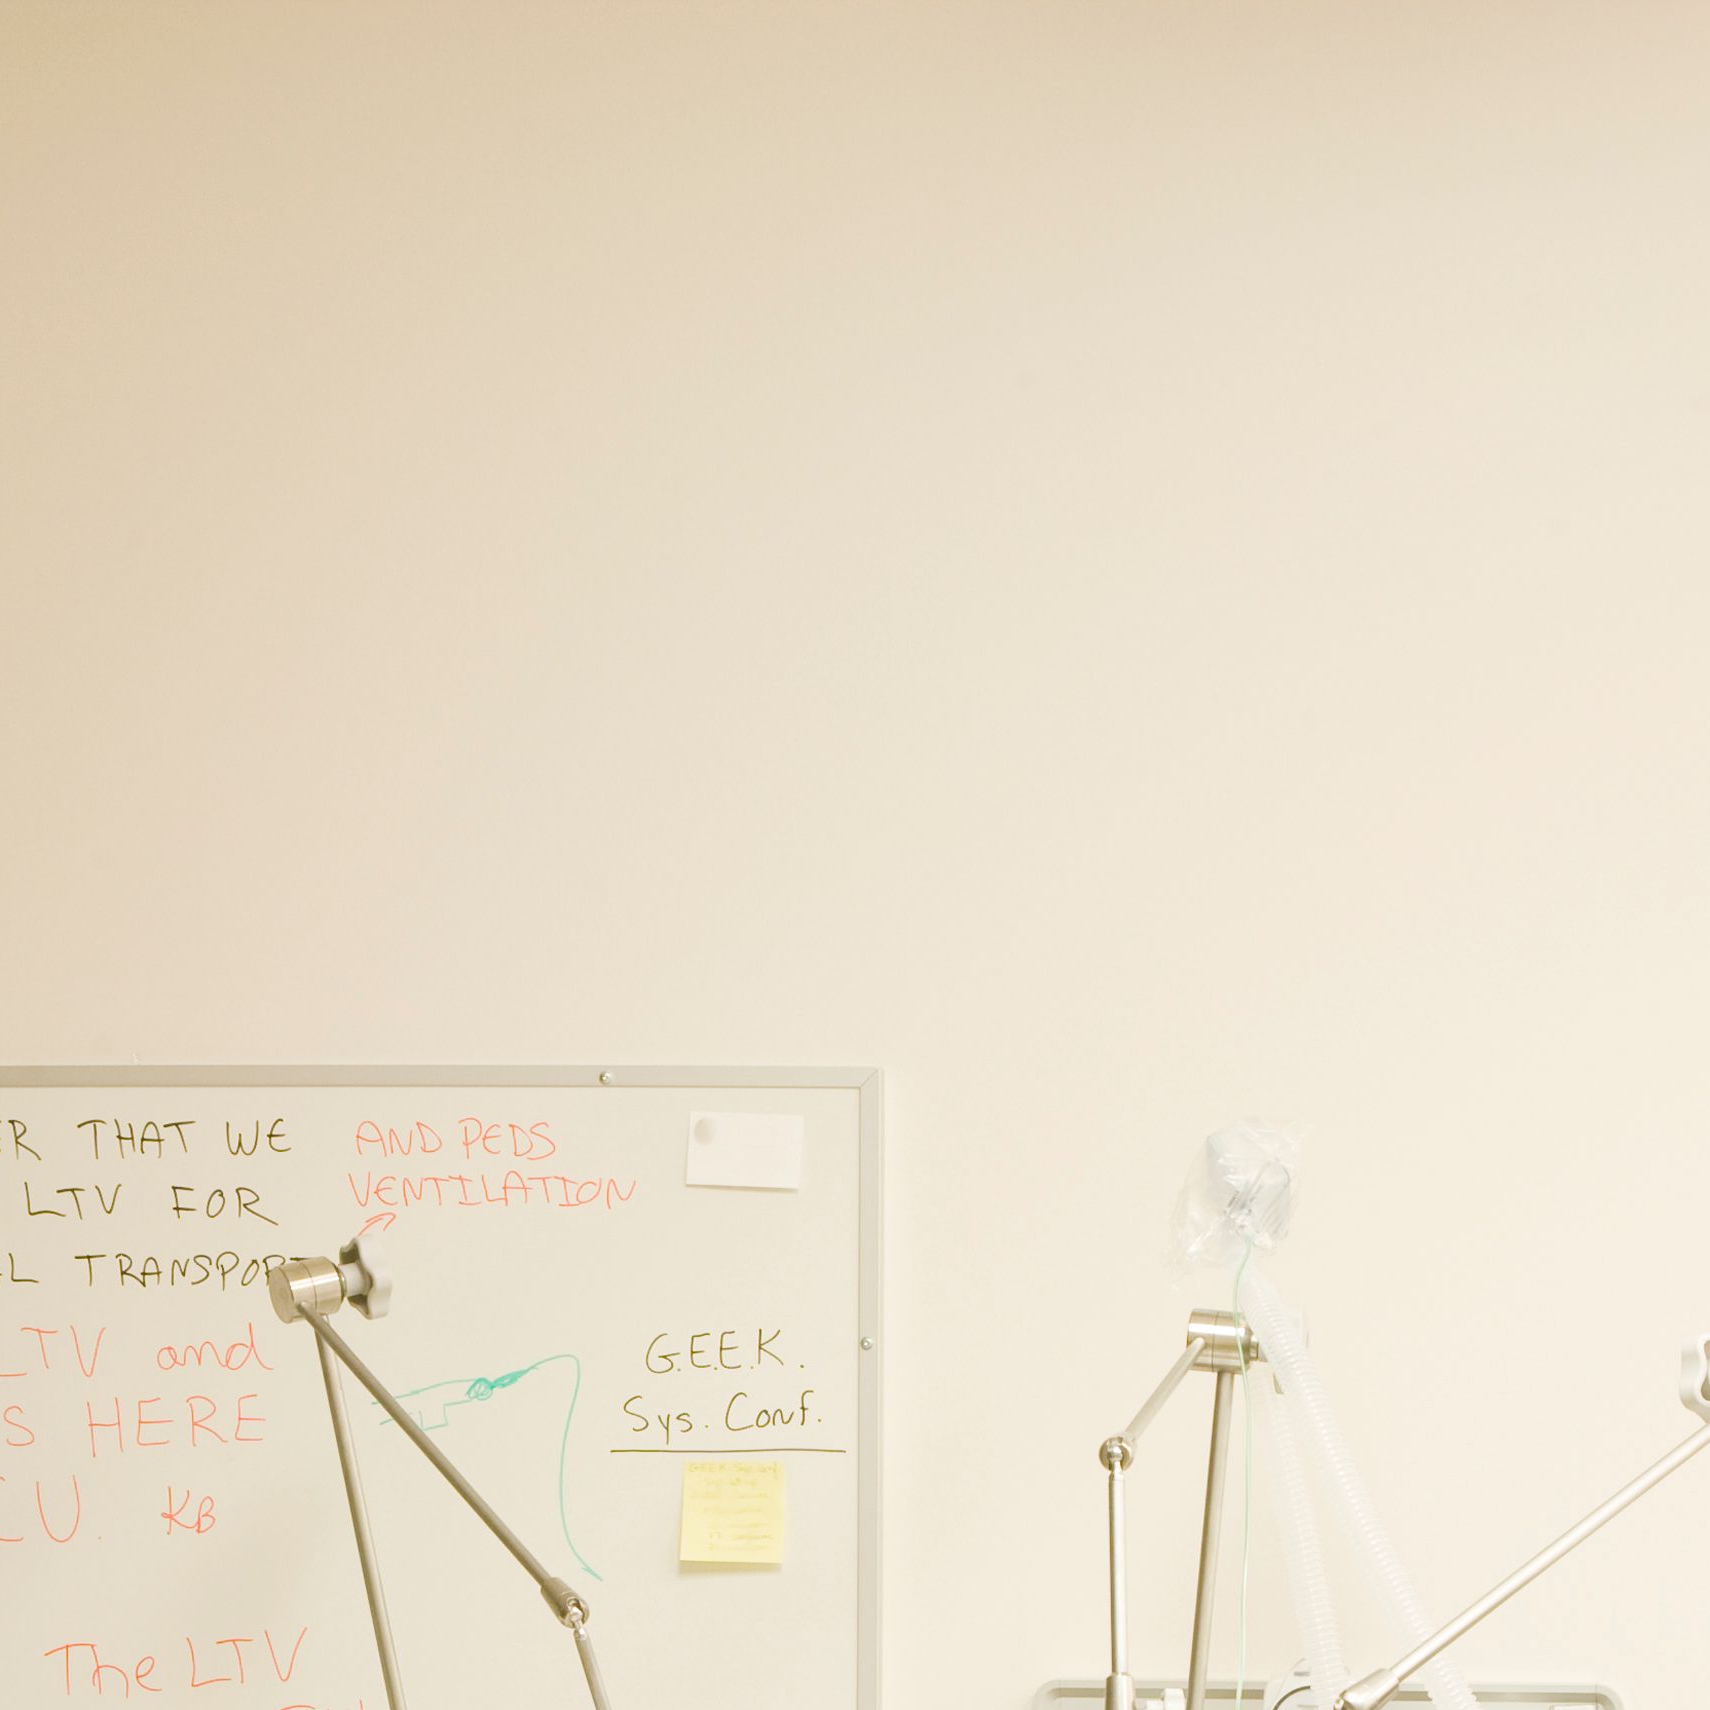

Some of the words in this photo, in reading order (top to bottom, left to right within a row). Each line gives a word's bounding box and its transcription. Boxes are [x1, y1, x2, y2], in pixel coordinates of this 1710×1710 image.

[77, 1119, 197, 1161] THAT
[225, 1118, 293, 1157] WE
[355, 1120, 444, 1157] AND
[459, 1117, 557, 1161] PEDS
[24, 1181, 122, 1220] LTV
[171, 1185, 279, 1227] FOR
[348, 1169, 637, 1211] VENTILATION
[156, 1322, 274, 1372] and
[86, 1394, 267, 1459] HERE
[185, 1626, 308, 1688] LTV
